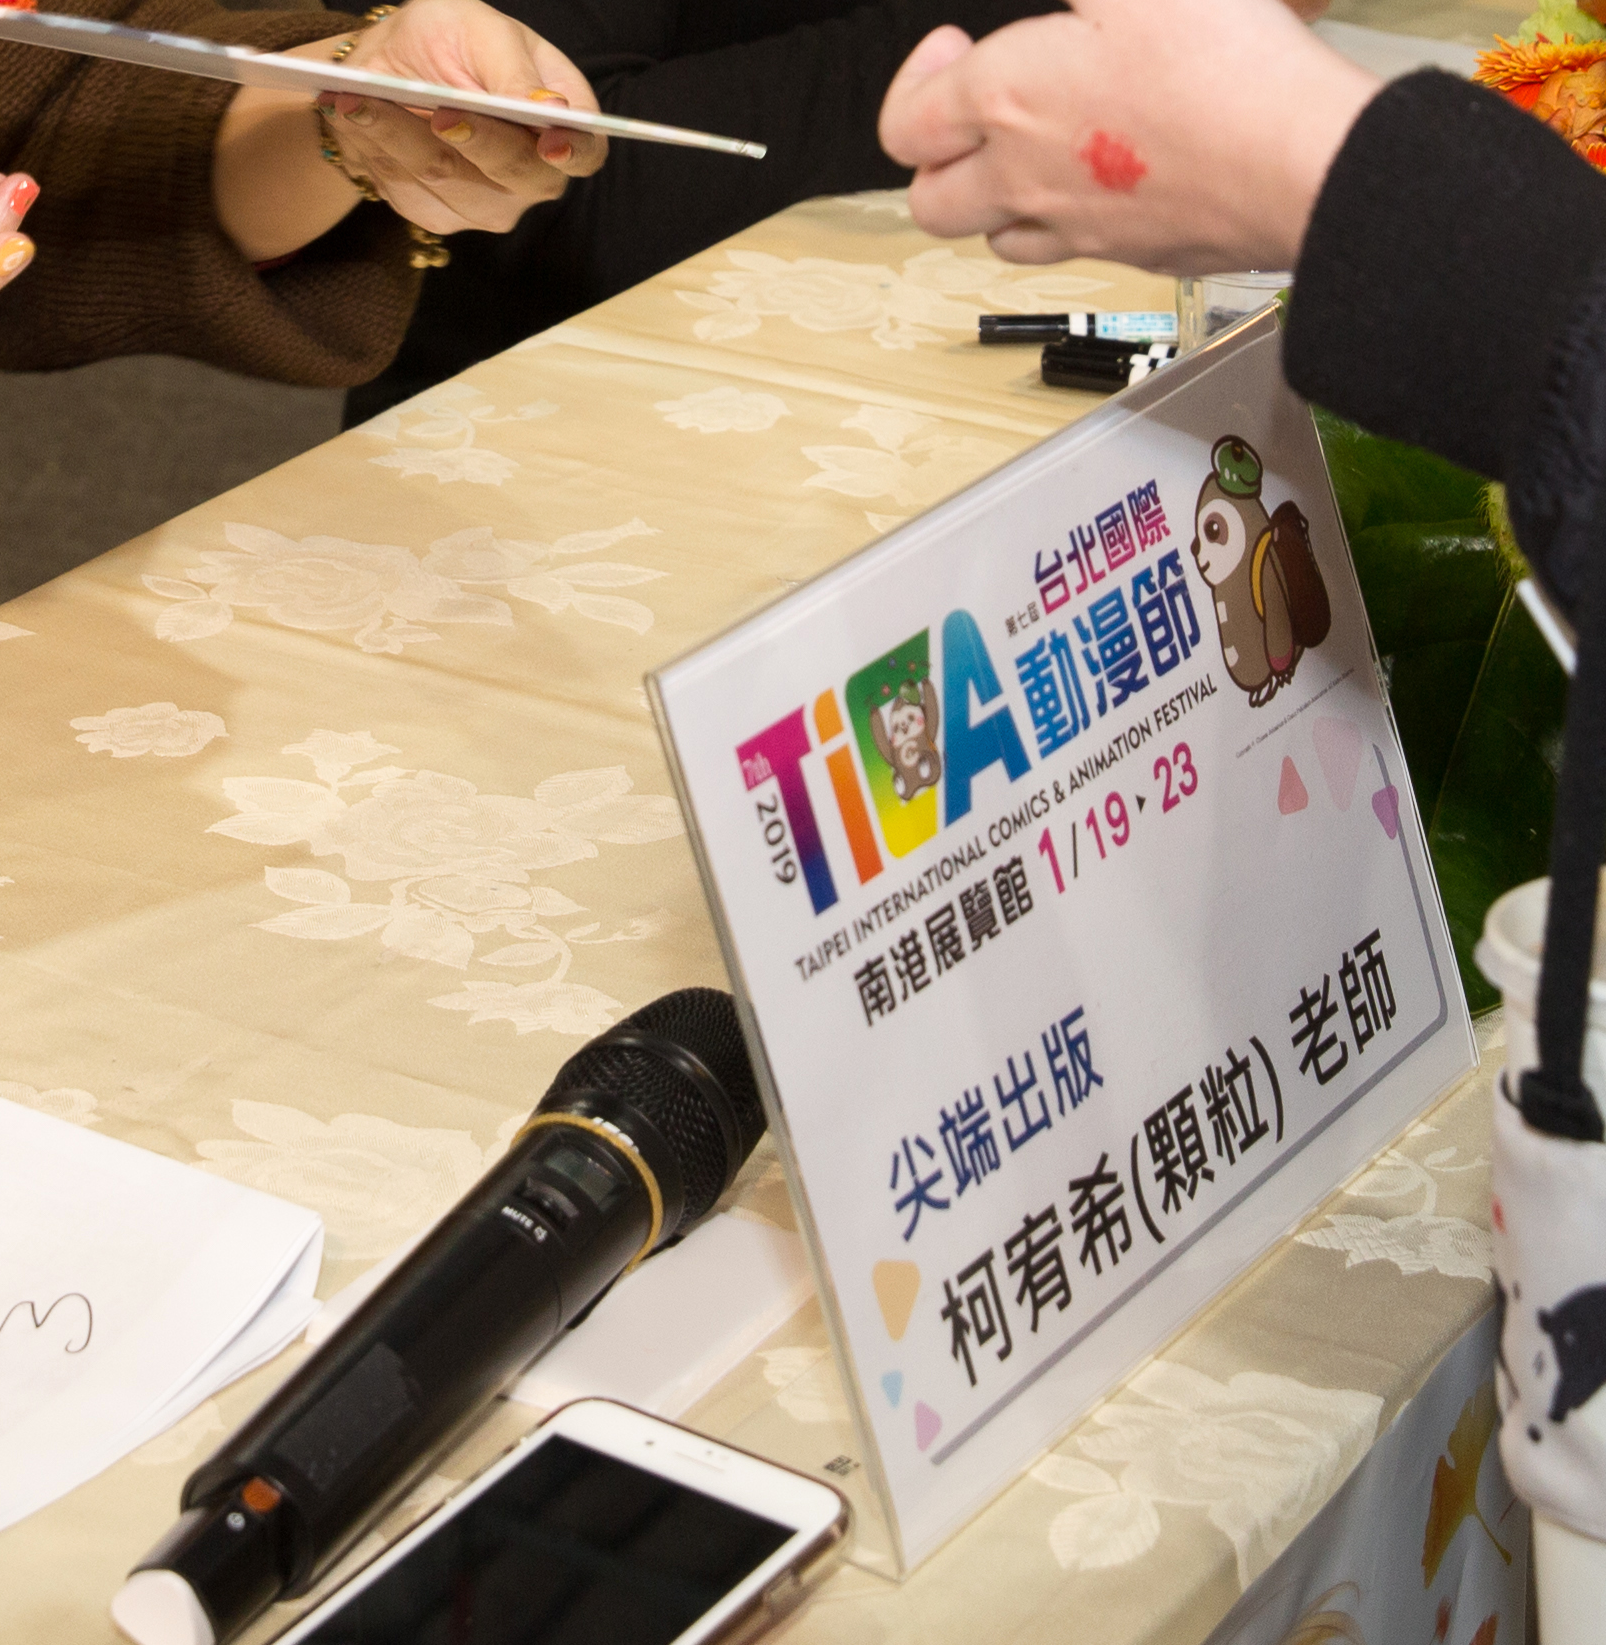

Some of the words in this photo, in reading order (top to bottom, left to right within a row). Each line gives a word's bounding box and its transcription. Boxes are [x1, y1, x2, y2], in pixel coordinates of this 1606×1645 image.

[1034, 478, 1171, 615] 台北國際
[1014, 547, 1202, 761] 動漫節
[756, 792, 798, 886] 2019
[794, 927, 851, 981] TAIPEI
[853, 836, 987, 942] INTERNATIONAL
[987, 789, 1051, 848] COMICS
[1053, 781, 1066, 804] &
[1069, 720, 1153, 793] ANIMATION
[1153, 673, 1218, 733] FESTIVAL
[853, 855, 1033, 1027] 南港展覽館
[1288, 928, 1399, 1086] 老師
[889, 1005, 1104, 1243] 尖端出版
[501, 1205, 534, 1230] MUTE
